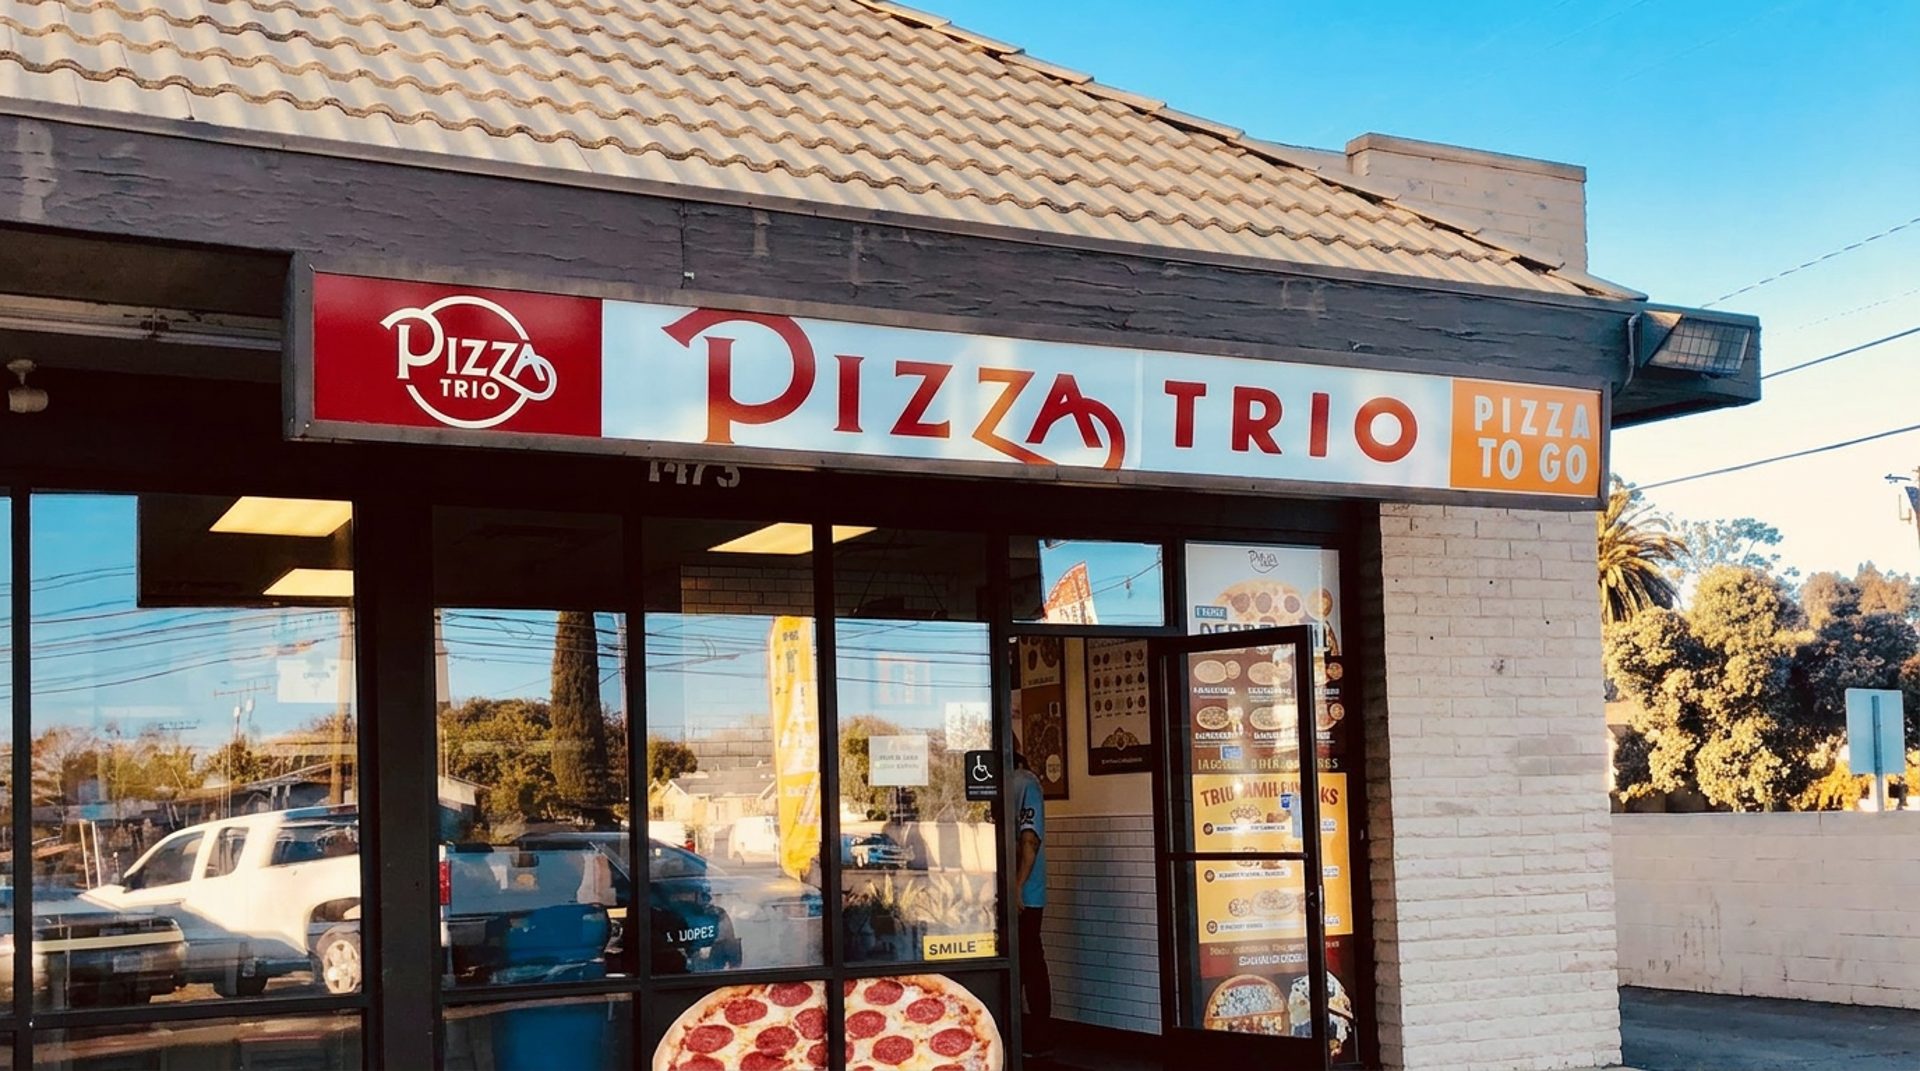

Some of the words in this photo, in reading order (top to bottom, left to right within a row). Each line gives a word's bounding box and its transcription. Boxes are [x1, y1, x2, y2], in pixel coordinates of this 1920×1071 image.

[380, 308, 557, 401] PIZZA
[439, 378, 500, 401] TRIO
[661, 308, 1126, 470] PIZZA
[1163, 379, 1418, 464] TRIO
[1473, 395, 1591, 441] PIZZA
[1478, 436, 1523, 480] TO
[1538, 440, 1588, 485] GO
[928, 941, 977, 956] SMILE
